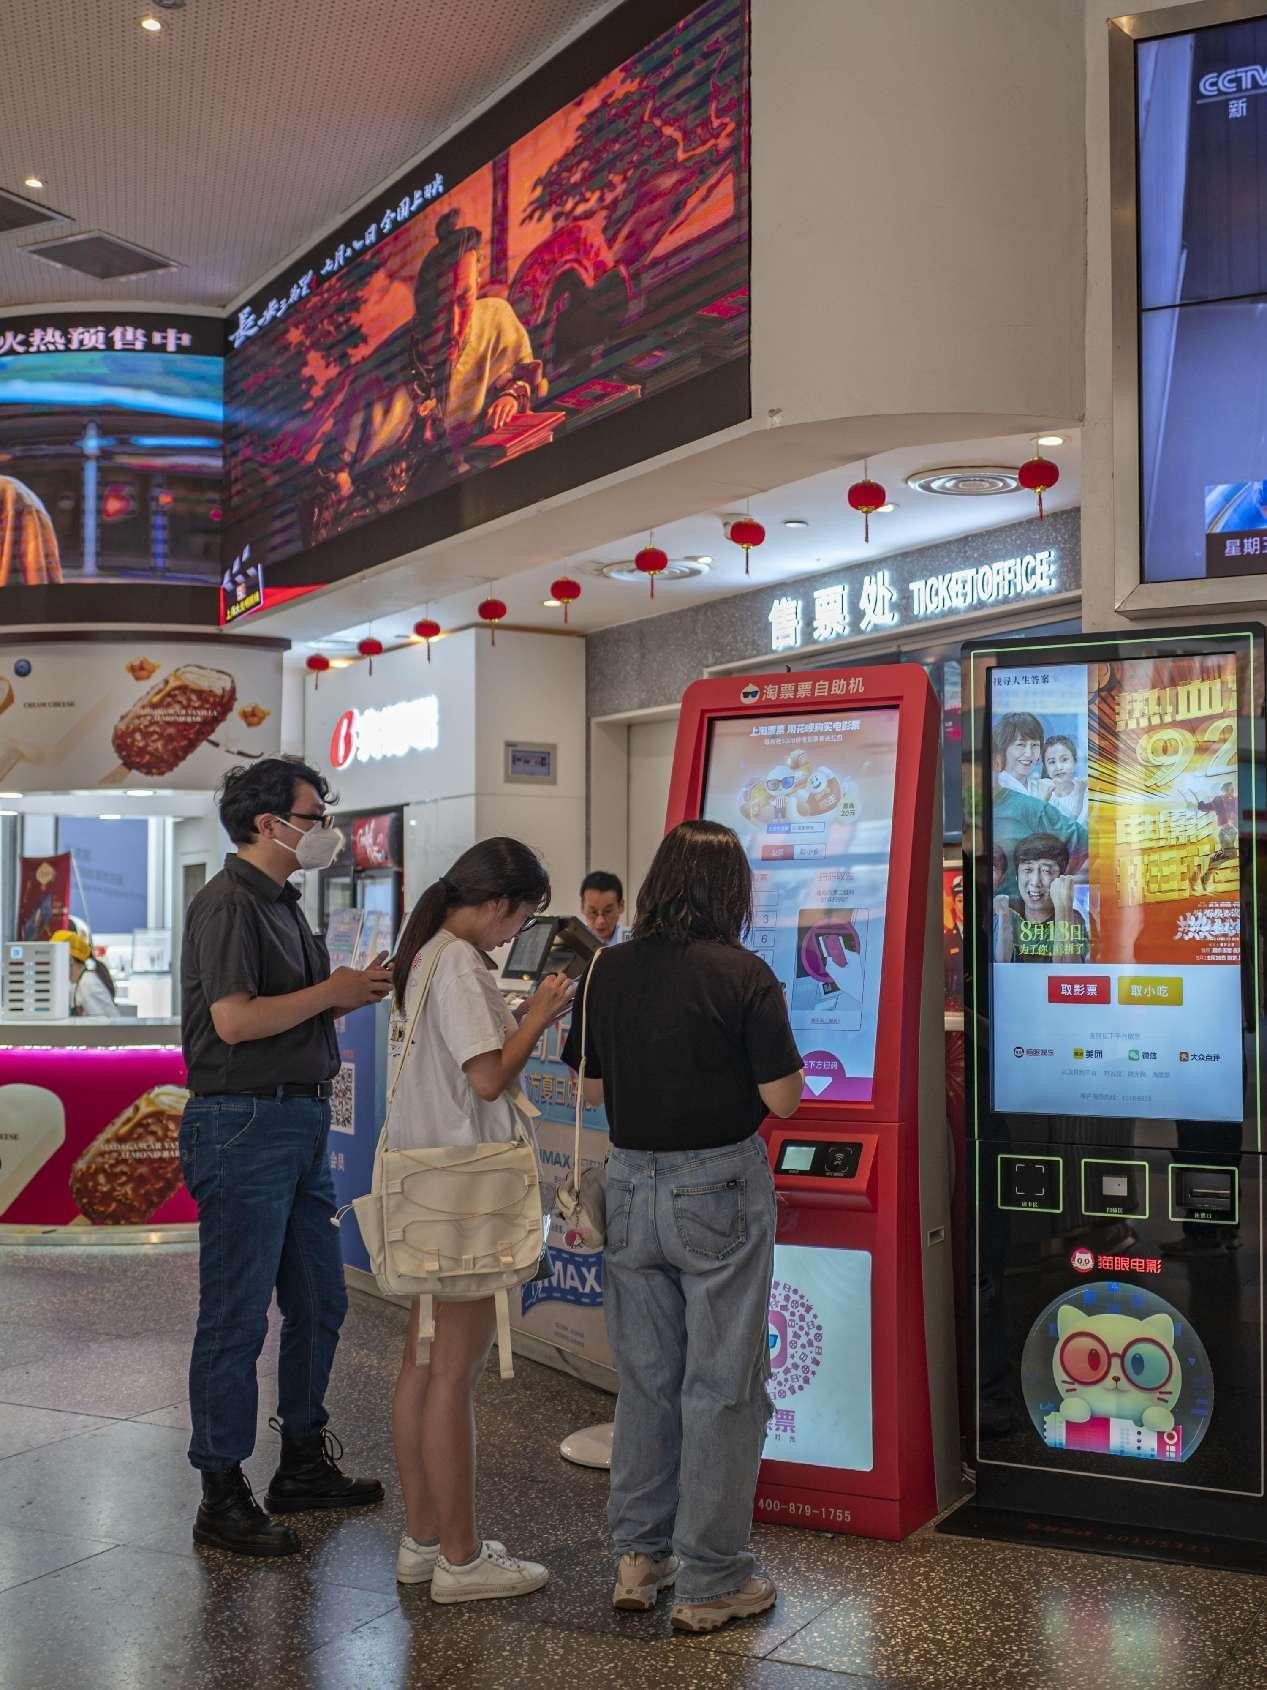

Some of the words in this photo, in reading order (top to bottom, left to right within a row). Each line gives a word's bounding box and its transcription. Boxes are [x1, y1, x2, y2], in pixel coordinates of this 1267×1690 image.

[0, 326, 192, 352] 火热预售中
[769, 569, 898, 651] 售票处
[762, 677, 865, 702] 淘票票自助机
[760, 934, 768, 944] 6
[1060, 983, 1099, 998] 取影票
[1130, 984, 1169, 998] 取小吃
[1085, 1048, 1103, 1059] 美团
[1190, 1053, 1221, 1063] 大众点评
[1097, 1256, 1162, 1274] 猫眼电影
[757, 1497, 852, 1523] 400-879-1755
